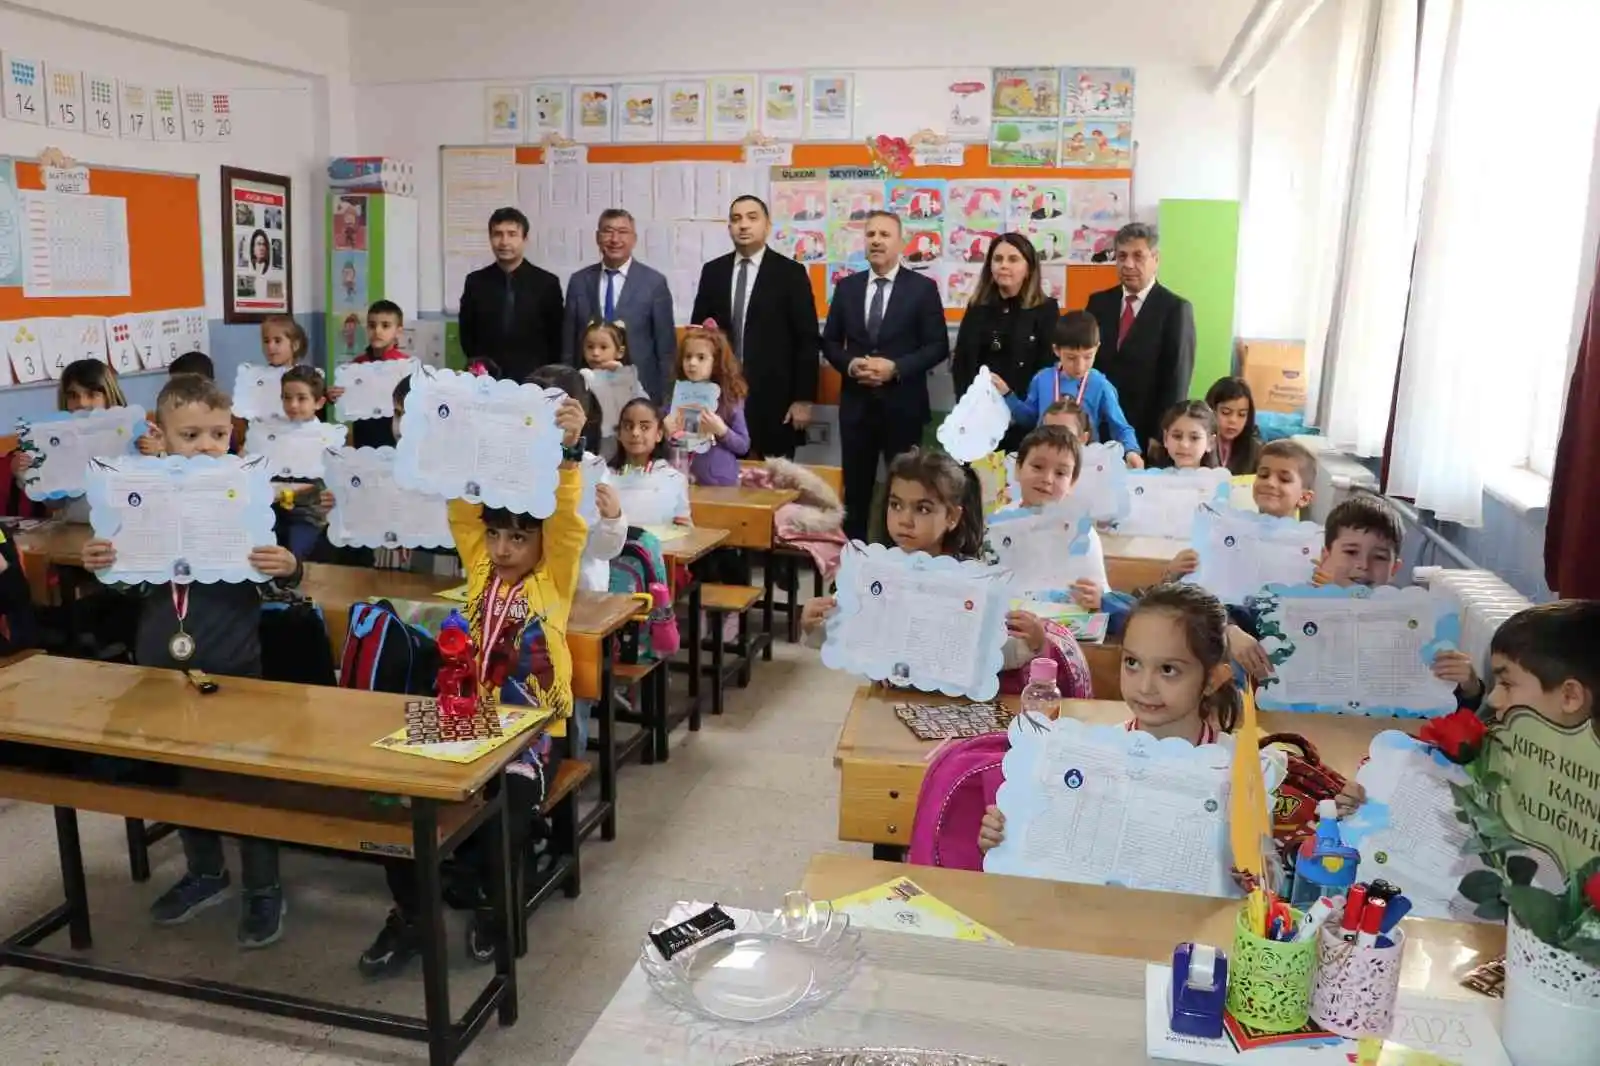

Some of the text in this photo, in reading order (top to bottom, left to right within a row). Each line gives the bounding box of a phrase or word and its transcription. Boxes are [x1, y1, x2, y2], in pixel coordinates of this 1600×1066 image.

[15, 92, 36, 115] 14
[59, 103, 76, 124] 15
[95, 109, 112, 130] 16
[130, 113, 144, 134] 17
[161, 116, 175, 135] 18
[192, 119, 205, 137] 19
[216, 118, 232, 136] 20
[55, 351, 65, 369] 4
[120, 348, 130, 367] 6
[144, 345, 153, 364] 7
[169, 342, 178, 360] 8
[24, 356, 36, 376] 3
[1513, 733, 1556, 770] KIPIR
[1548, 781, 1600, 824] KARN
[1517, 793, 1588, 845] ALDIĞIM
[1393, 1012, 1473, 1048] 2023
